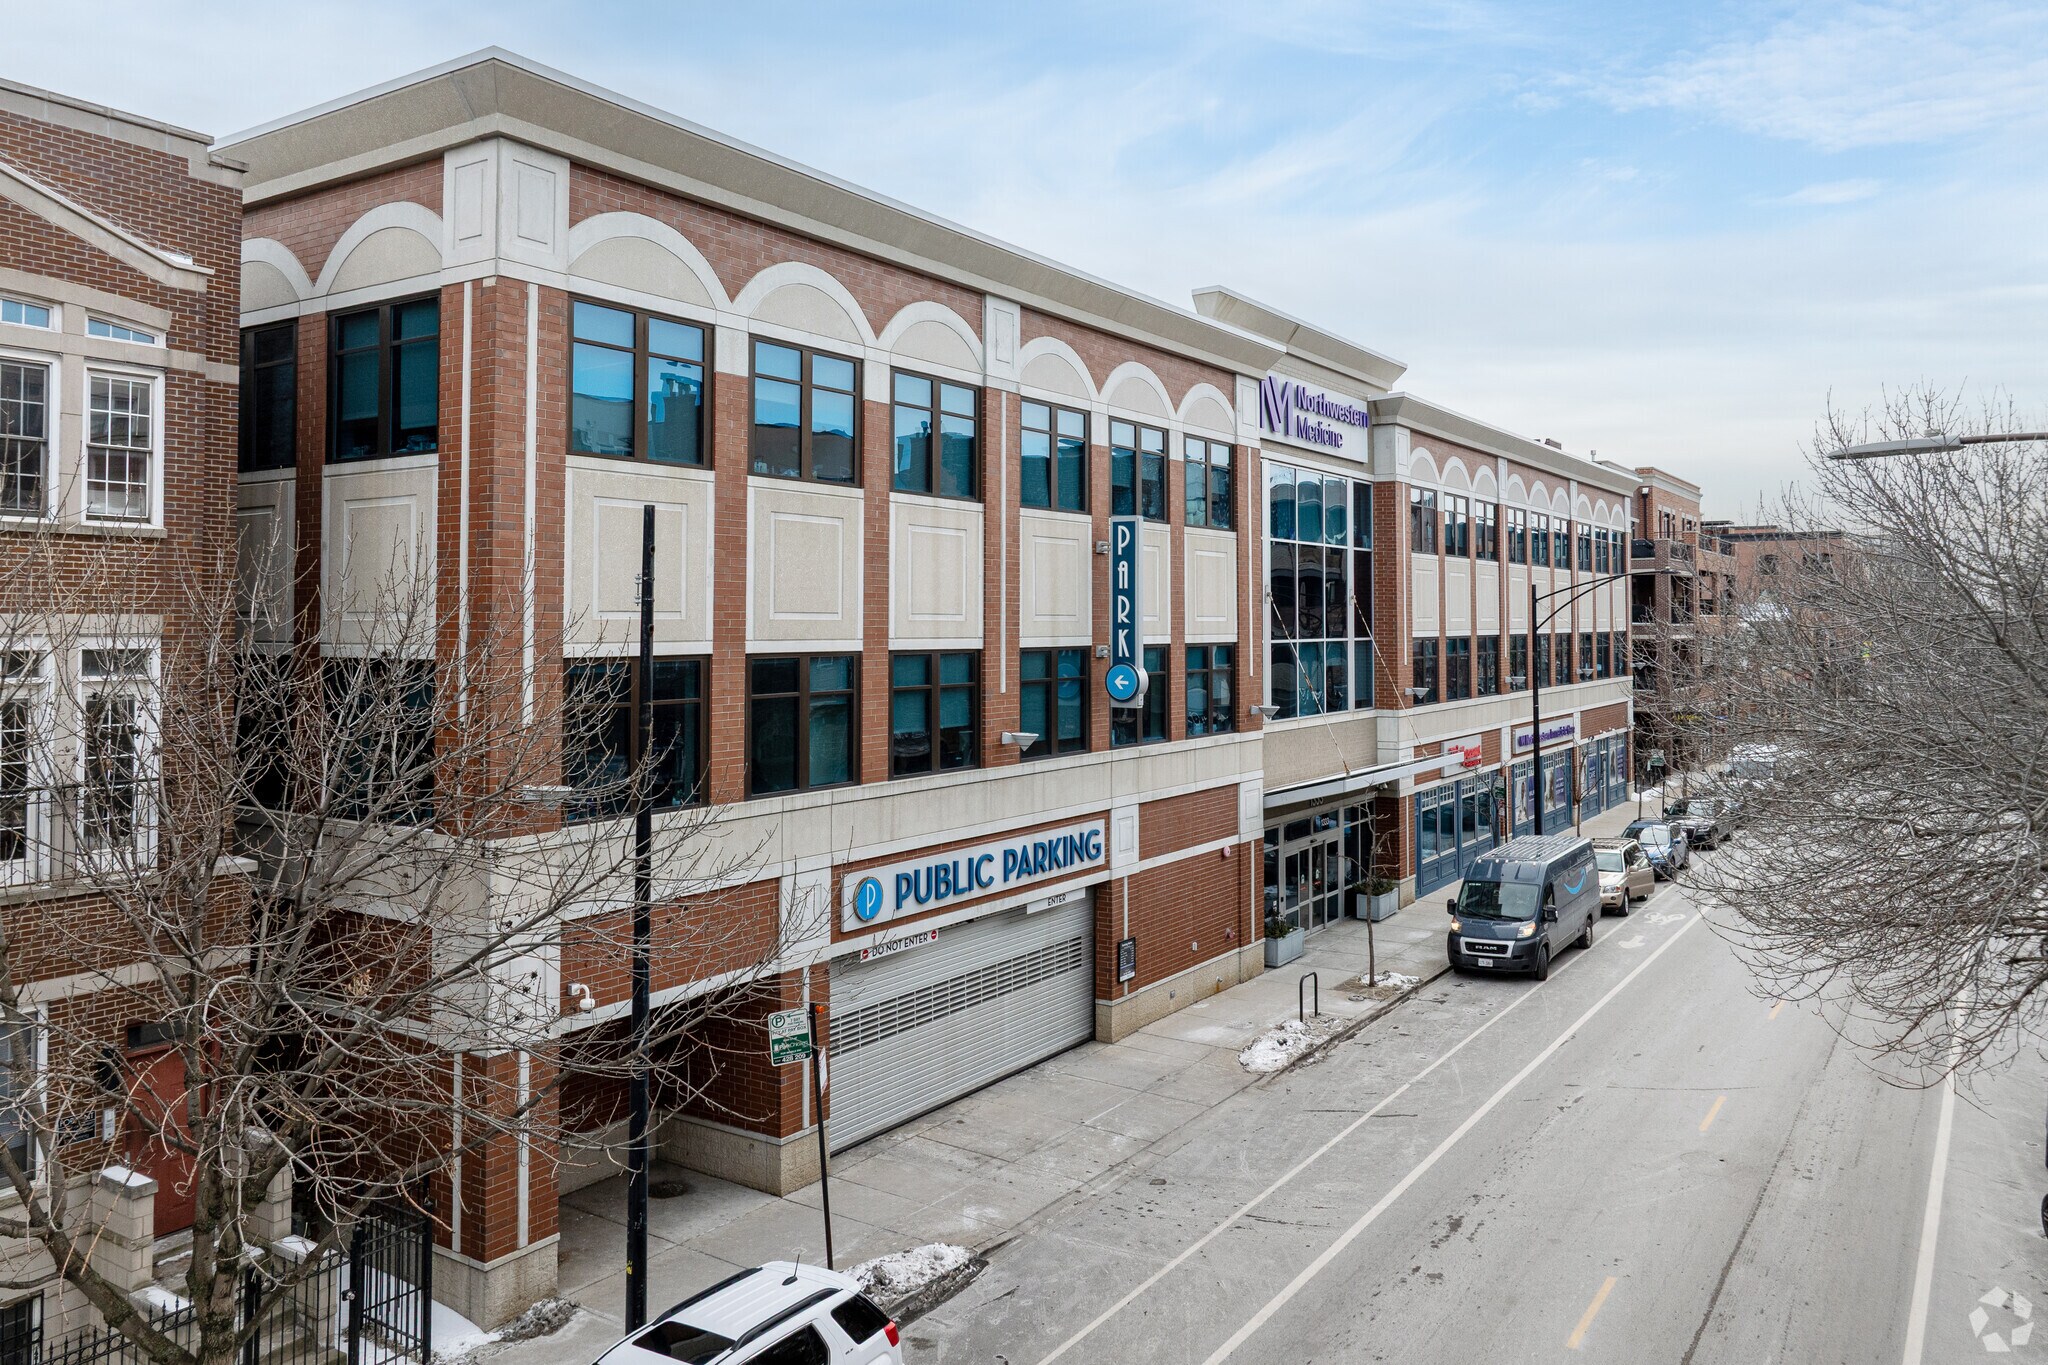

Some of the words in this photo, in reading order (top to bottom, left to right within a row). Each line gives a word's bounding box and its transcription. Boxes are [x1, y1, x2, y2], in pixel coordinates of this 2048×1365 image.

[1296, 385, 1369, 429] Northwestern
[1296, 414, 1343, 449] Medicine
[1117, 524, 1131, 658] PARK
[895, 853, 995, 911] PUBLIC
[1003, 828, 1102, 883] PARKING
[1047, 893, 1067, 907] ENTER
[871, 945, 885, 958] DO
[886, 938, 903, 952] NOT
[903, 932, 928, 948] ENTER
